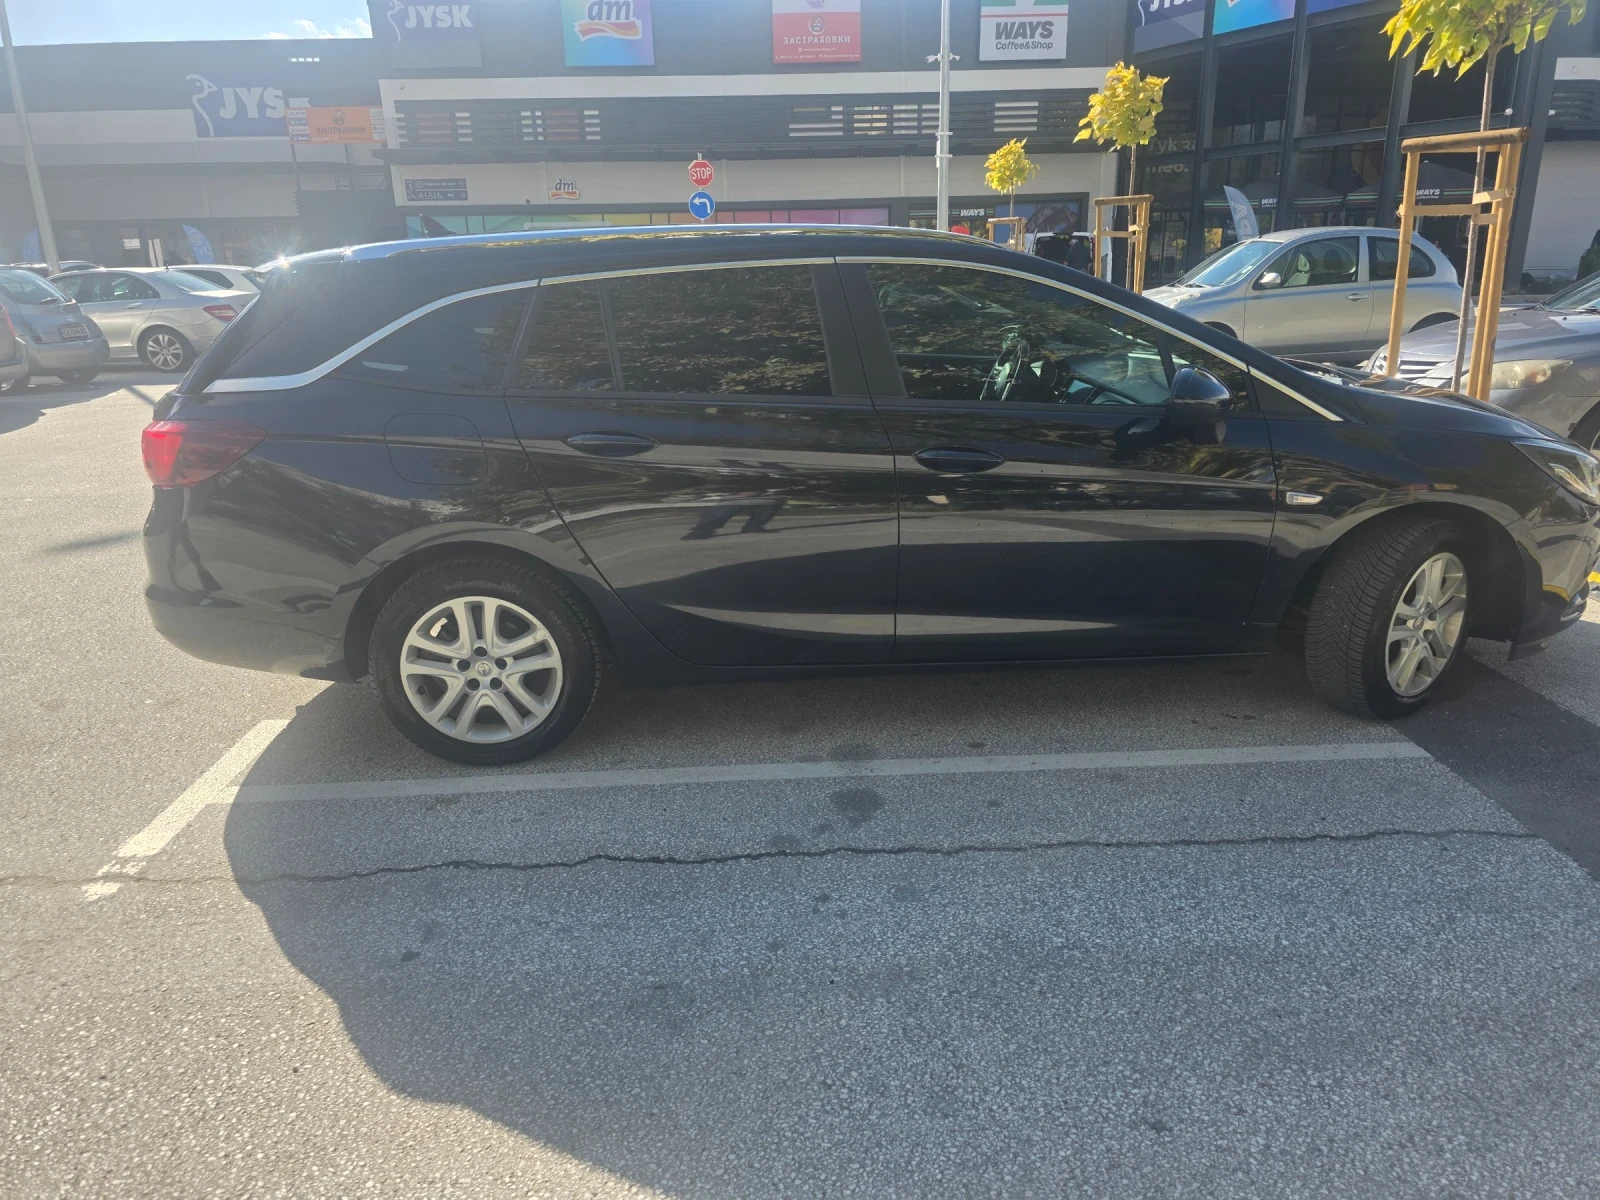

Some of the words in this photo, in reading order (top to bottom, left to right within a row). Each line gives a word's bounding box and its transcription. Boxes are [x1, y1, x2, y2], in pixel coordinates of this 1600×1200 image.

[404, 5, 473, 28] JYSK
[995, 20, 1054, 40] WAYS
[783, 36, 850, 44] ЗАСТРАХОВКИ
[995, 41, 1053, 50] Coffee&Shop
[691, 167, 712, 180] STOP
[555, 178, 574, 191] dm
[1416, 188, 1441, 196] WAYS
[960, 208, 985, 217] WAYS
